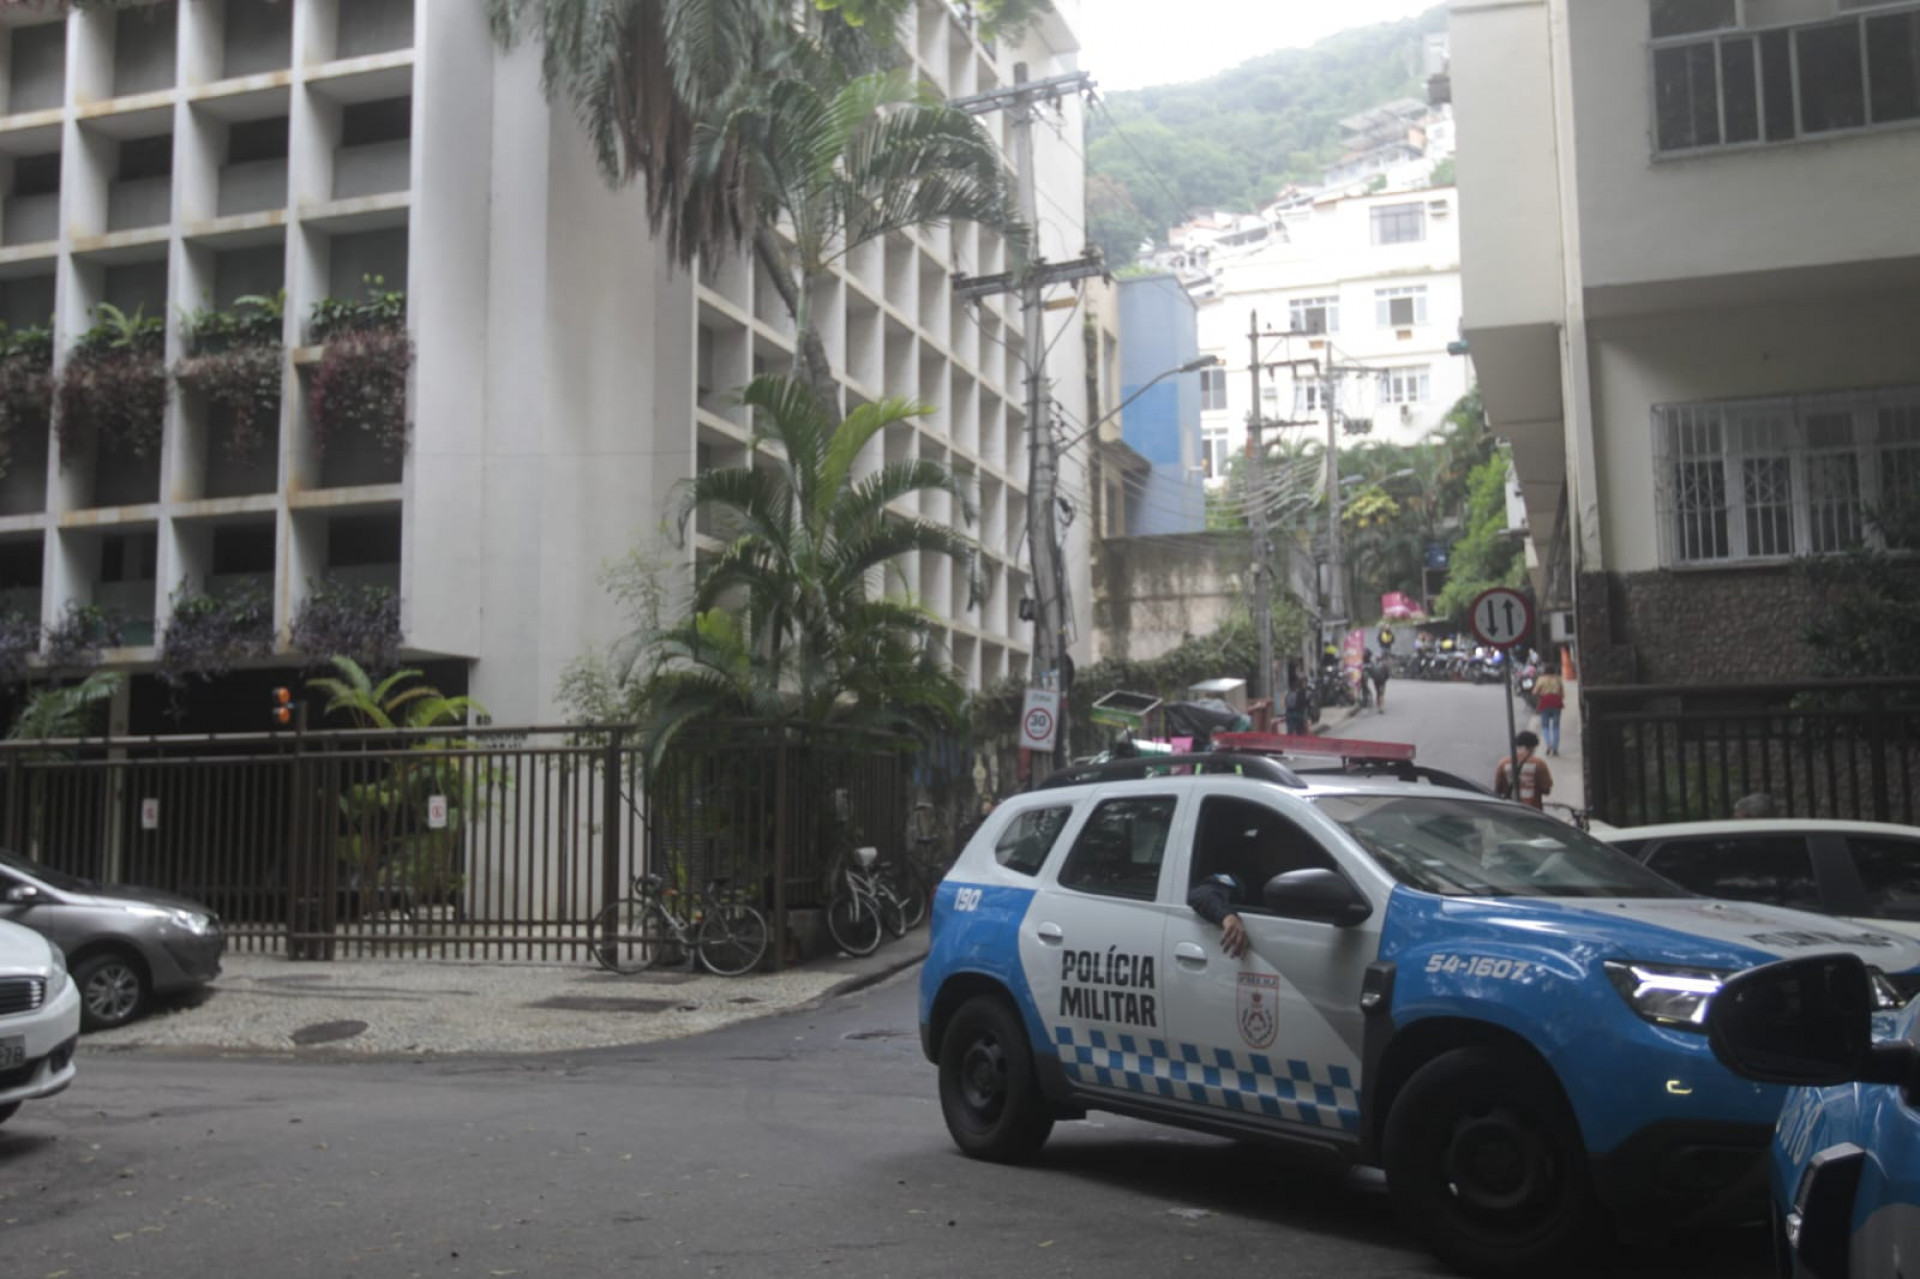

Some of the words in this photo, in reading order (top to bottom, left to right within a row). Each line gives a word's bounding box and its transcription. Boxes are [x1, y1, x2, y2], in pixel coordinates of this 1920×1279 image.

[1031, 714, 1046, 727] 30
[954, 887, 983, 912] 190
[1062, 944, 1155, 989] POLÍCIA
[1425, 954, 1529, 980] 54-1607
[1060, 986, 1157, 1027] MILITAR
